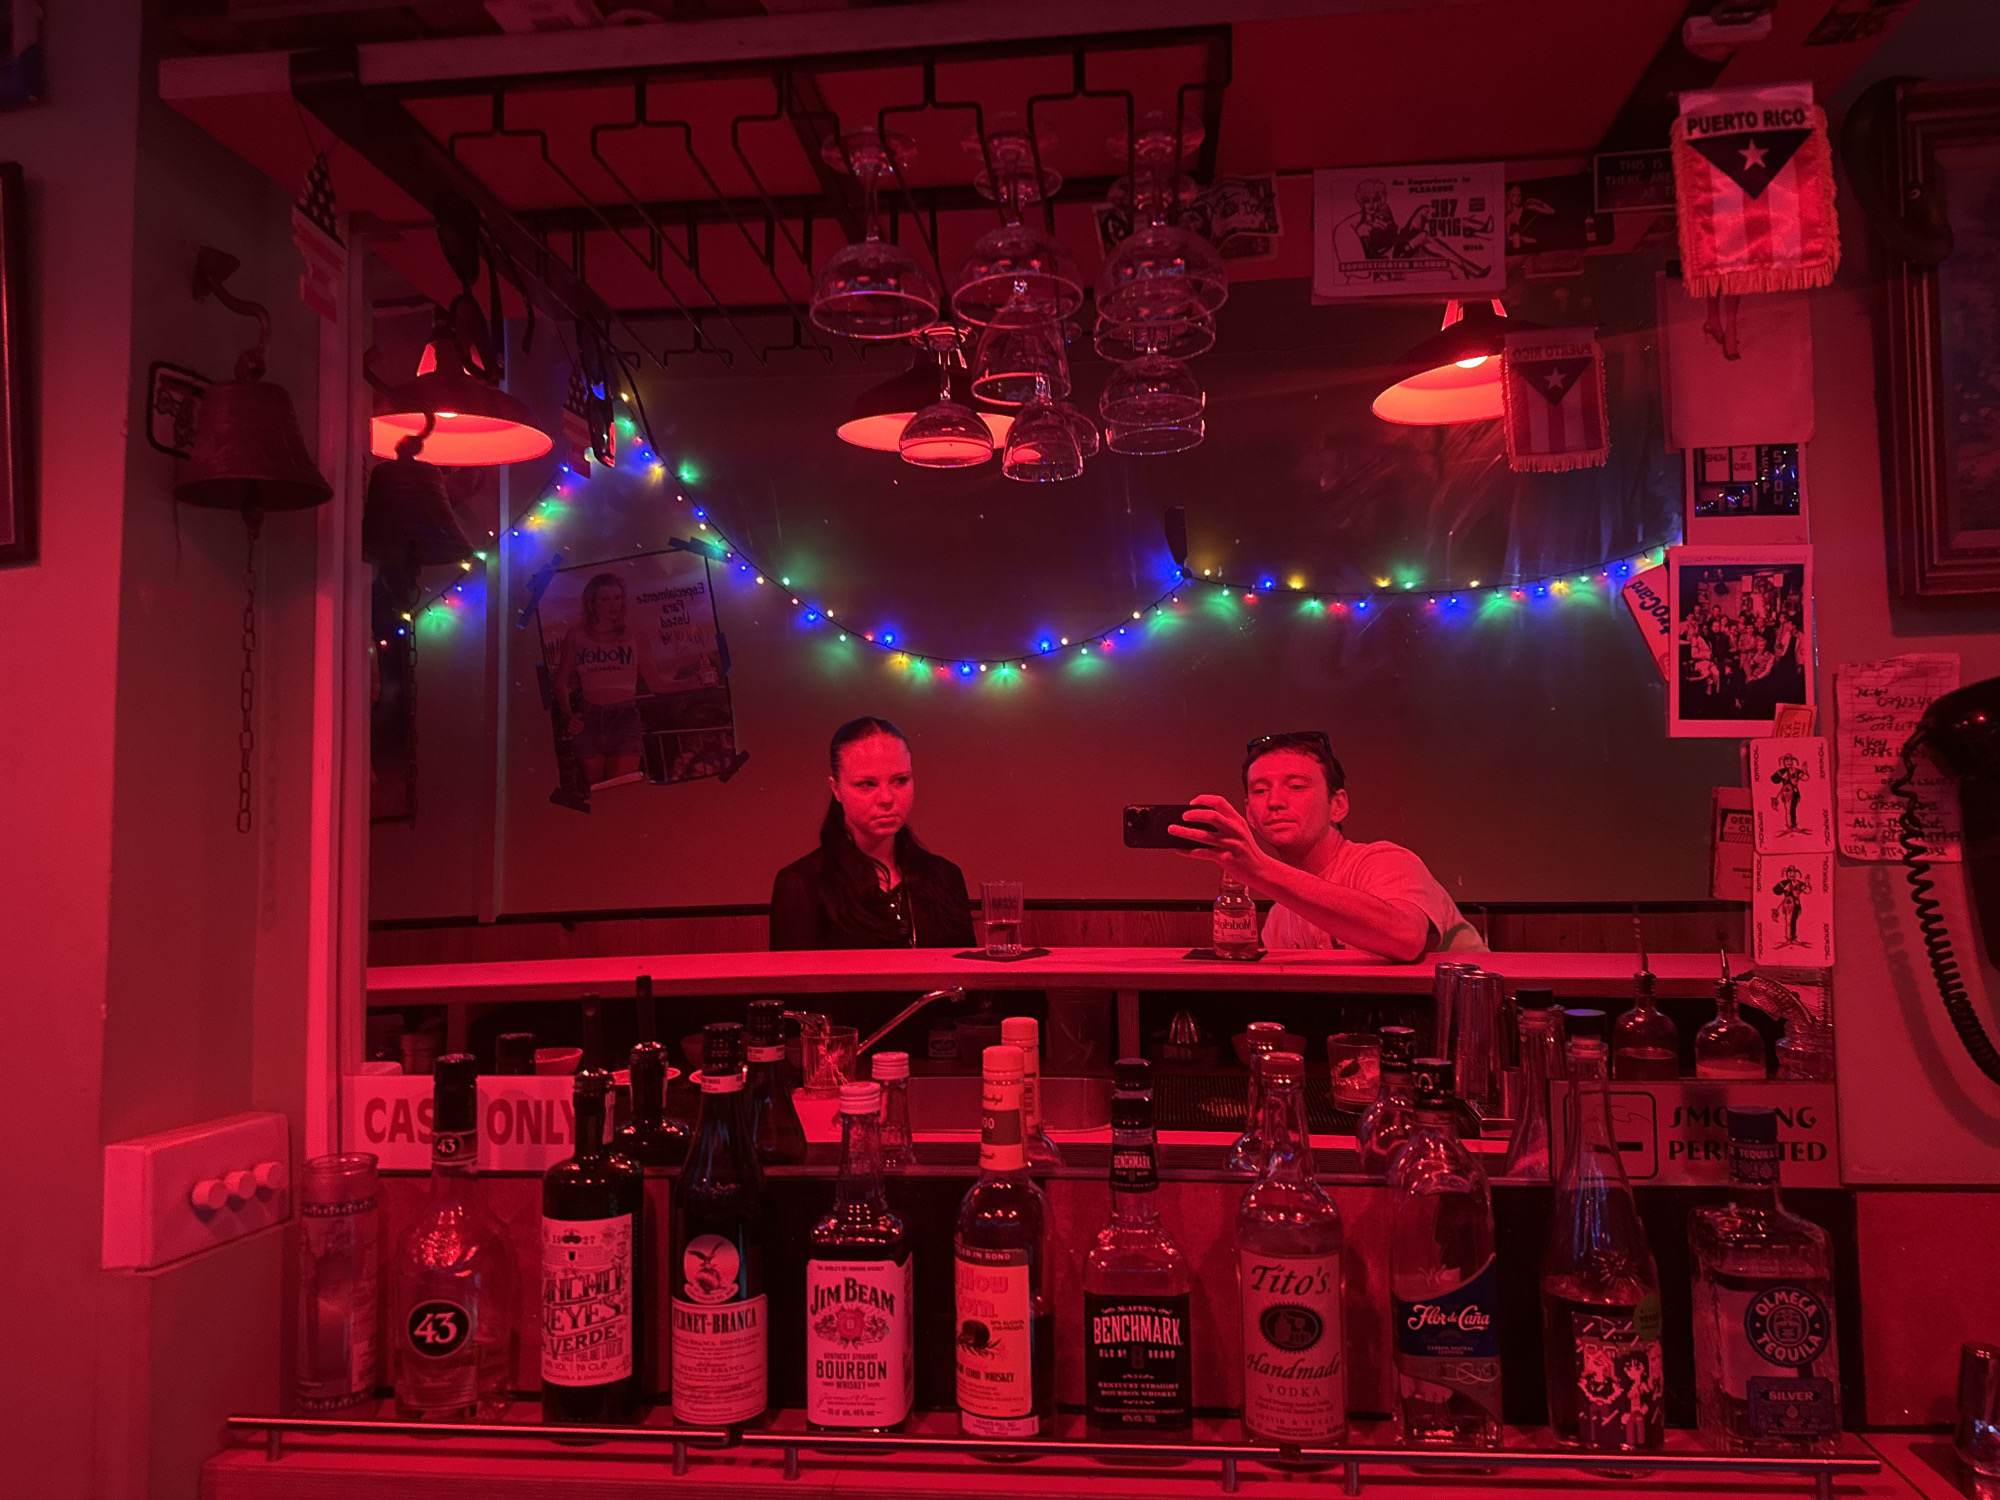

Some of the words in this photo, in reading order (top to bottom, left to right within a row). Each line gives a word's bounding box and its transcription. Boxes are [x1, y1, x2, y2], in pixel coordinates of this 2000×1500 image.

[1687, 111, 1758, 135] PUERTO
[1764, 108, 1805, 126] RICO
[1626, 580, 1671, 635] troCard
[364, 1097, 434, 1144] CAS
[1669, 1105, 1817, 1129] SMONG
[437, 1138, 457, 1154] 43
[1669, 1140, 1828, 1162] PERTED
[1251, 1264, 1331, 1296] Tito's
[810, 1284, 841, 1316] JIM
[844, 1277, 895, 1317] BEAM
[1755, 1291, 1818, 1317] OLMECA
[413, 1311, 458, 1344] 43
[543, 1295, 623, 1338] REYES
[1093, 1314, 1183, 1346] BENCHMARK
[1407, 1304, 1447, 1331] Flor
[1447, 1311, 1458, 1323] de
[1458, 1304, 1490, 1331] Caña
[550, 1324, 618, 1361] VERDE
[1099, 1349, 1115, 1358] OLD
[1148, 1350, 1175, 1359] BRAND
[1757, 1333, 1822, 1362] TEQUILA
[816, 1360, 887, 1380] BOURBON
[1246, 1351, 1341, 1380] Handmade
[836, 1381, 866, 1390] WHISKEY
[1140, 1382, 1179, 1390] STRAIGHT
[1266, 1382, 1322, 1398] VODKA
[1768, 1391, 1814, 1401] SILVER
